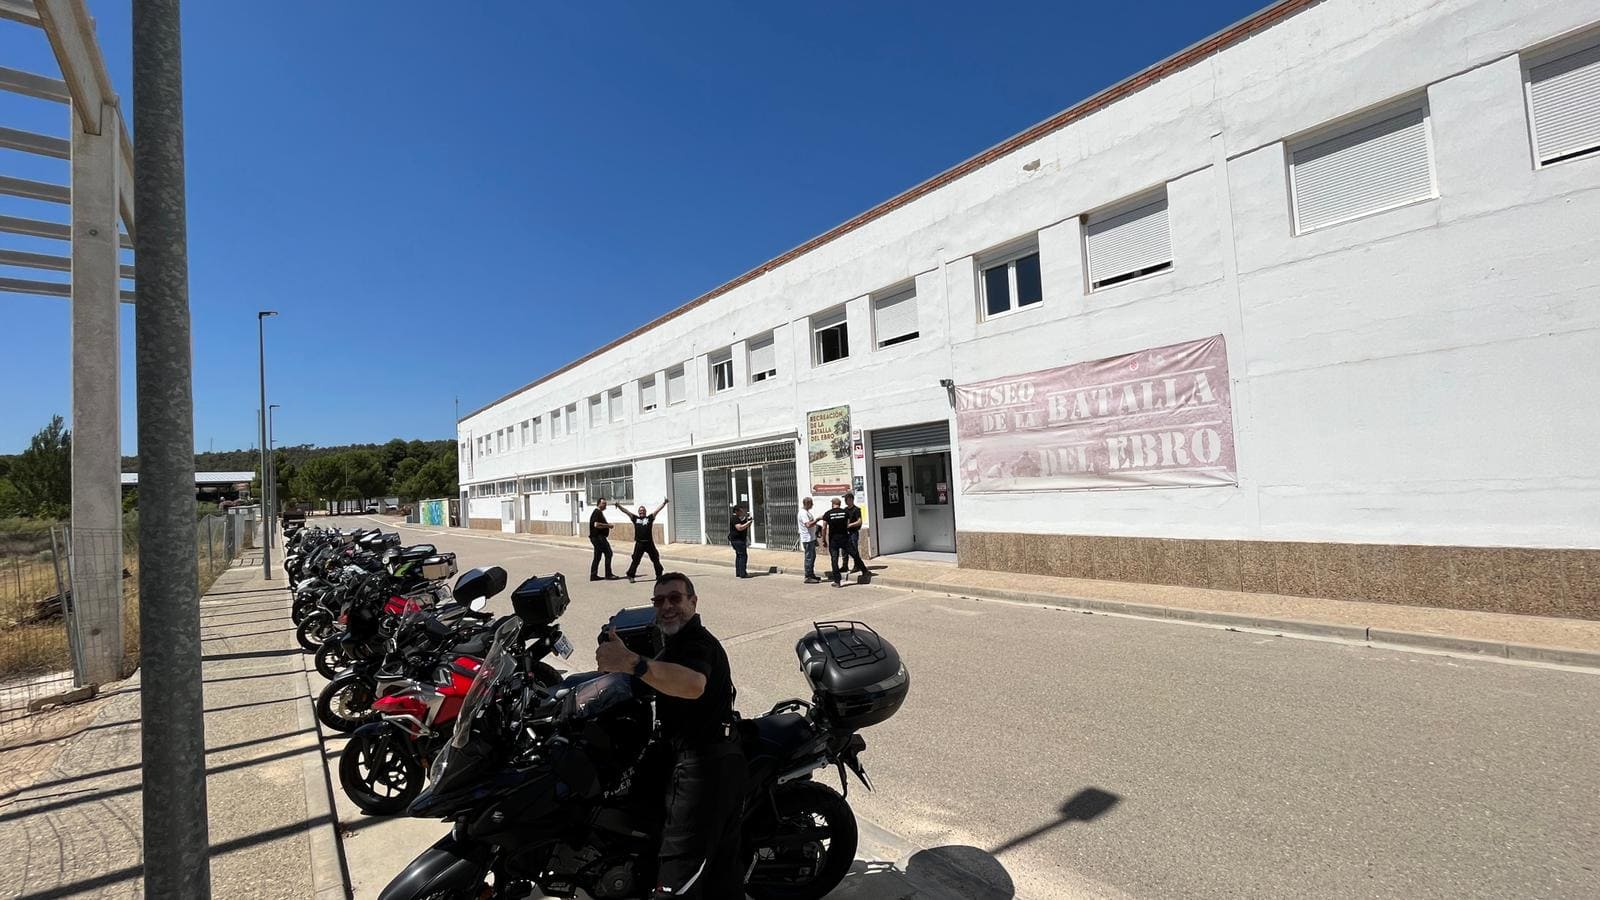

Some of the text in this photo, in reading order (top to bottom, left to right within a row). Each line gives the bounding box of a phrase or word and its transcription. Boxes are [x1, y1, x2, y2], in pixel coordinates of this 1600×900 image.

[960, 381, 1035, 411] MUSEO
[1048, 372, 1217, 422] BATALLA
[811, 427, 832, 435] BATALLA
[982, 412, 1042, 432] DE LA
[821, 433, 835, 441] EBRO
[1040, 428, 1222, 476] DEL EBRO
